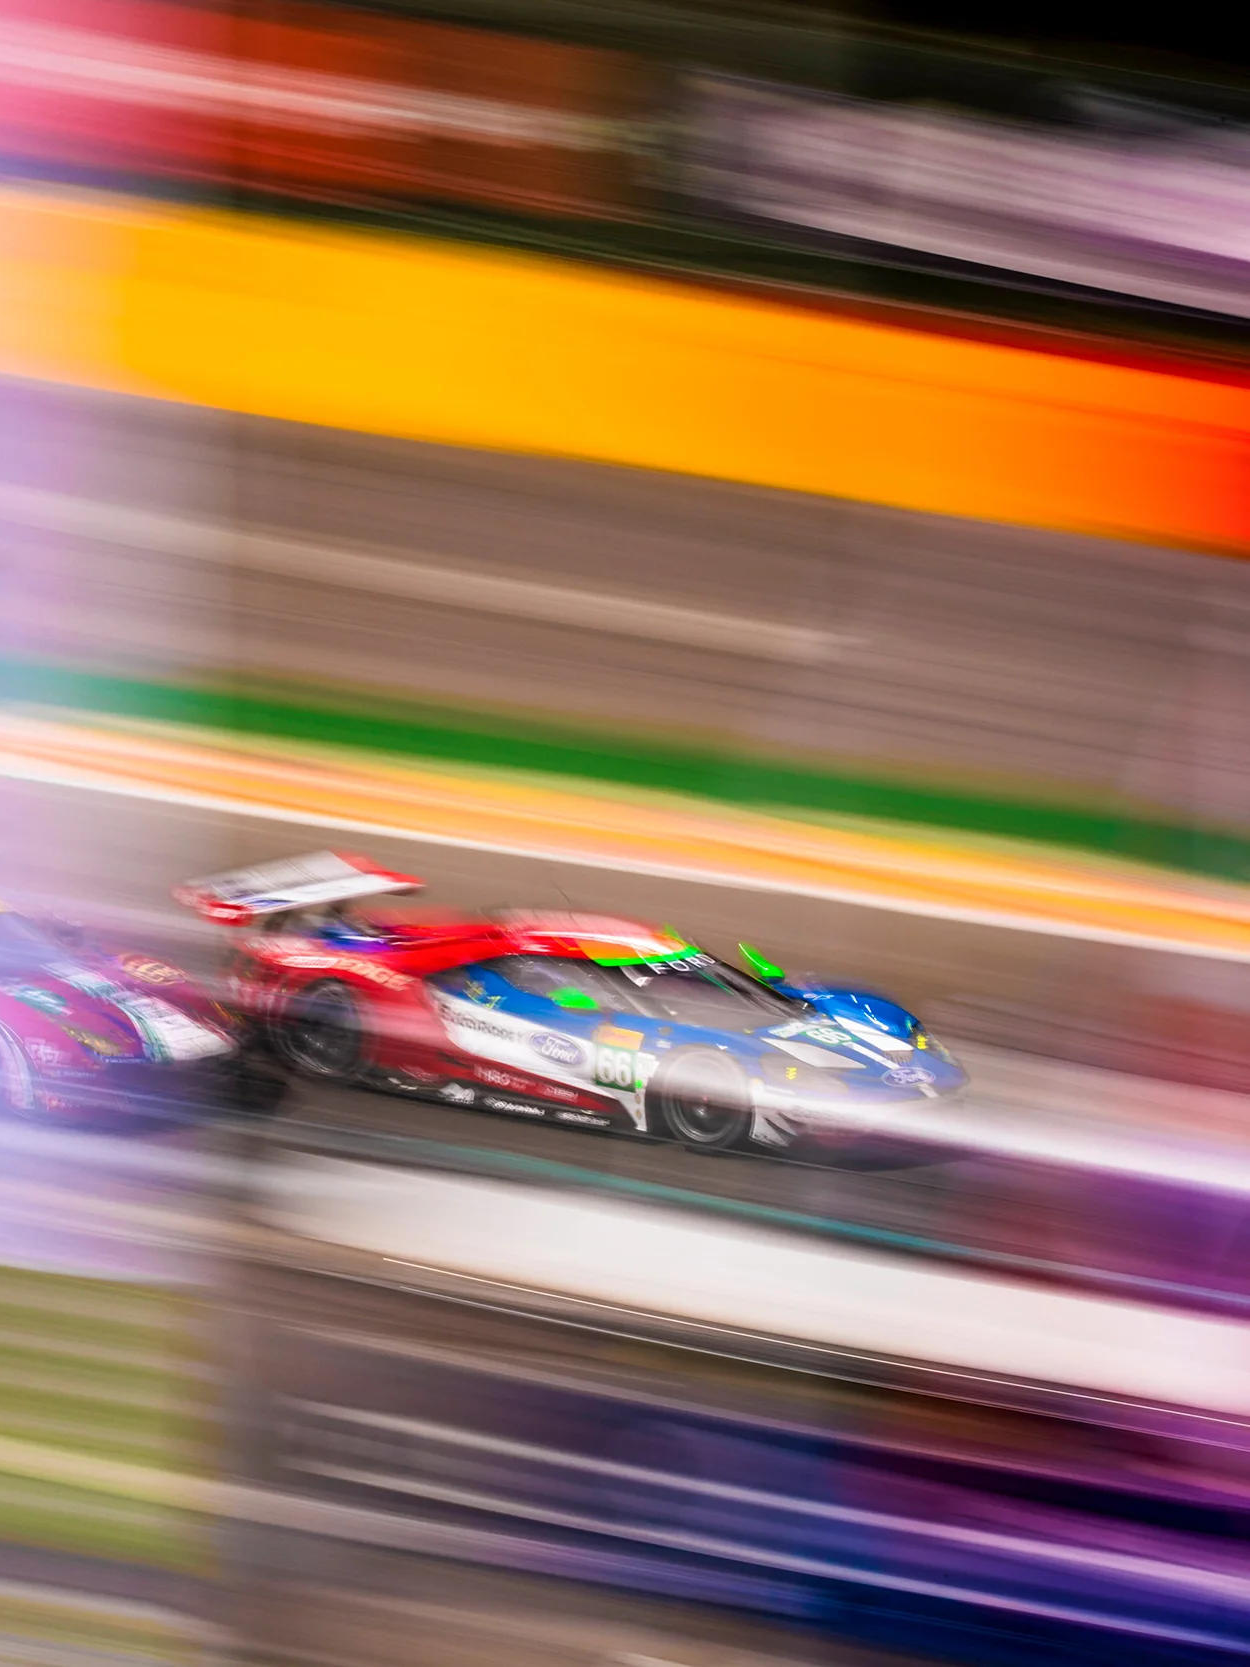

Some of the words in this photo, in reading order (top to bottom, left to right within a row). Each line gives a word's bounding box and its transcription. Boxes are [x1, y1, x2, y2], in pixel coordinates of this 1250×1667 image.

[648, 953, 716, 975] FORD
[805, 1027, 852, 1045] 66
[540, 1036, 578, 1065] Ford
[597, 1046, 632, 1086] 66
